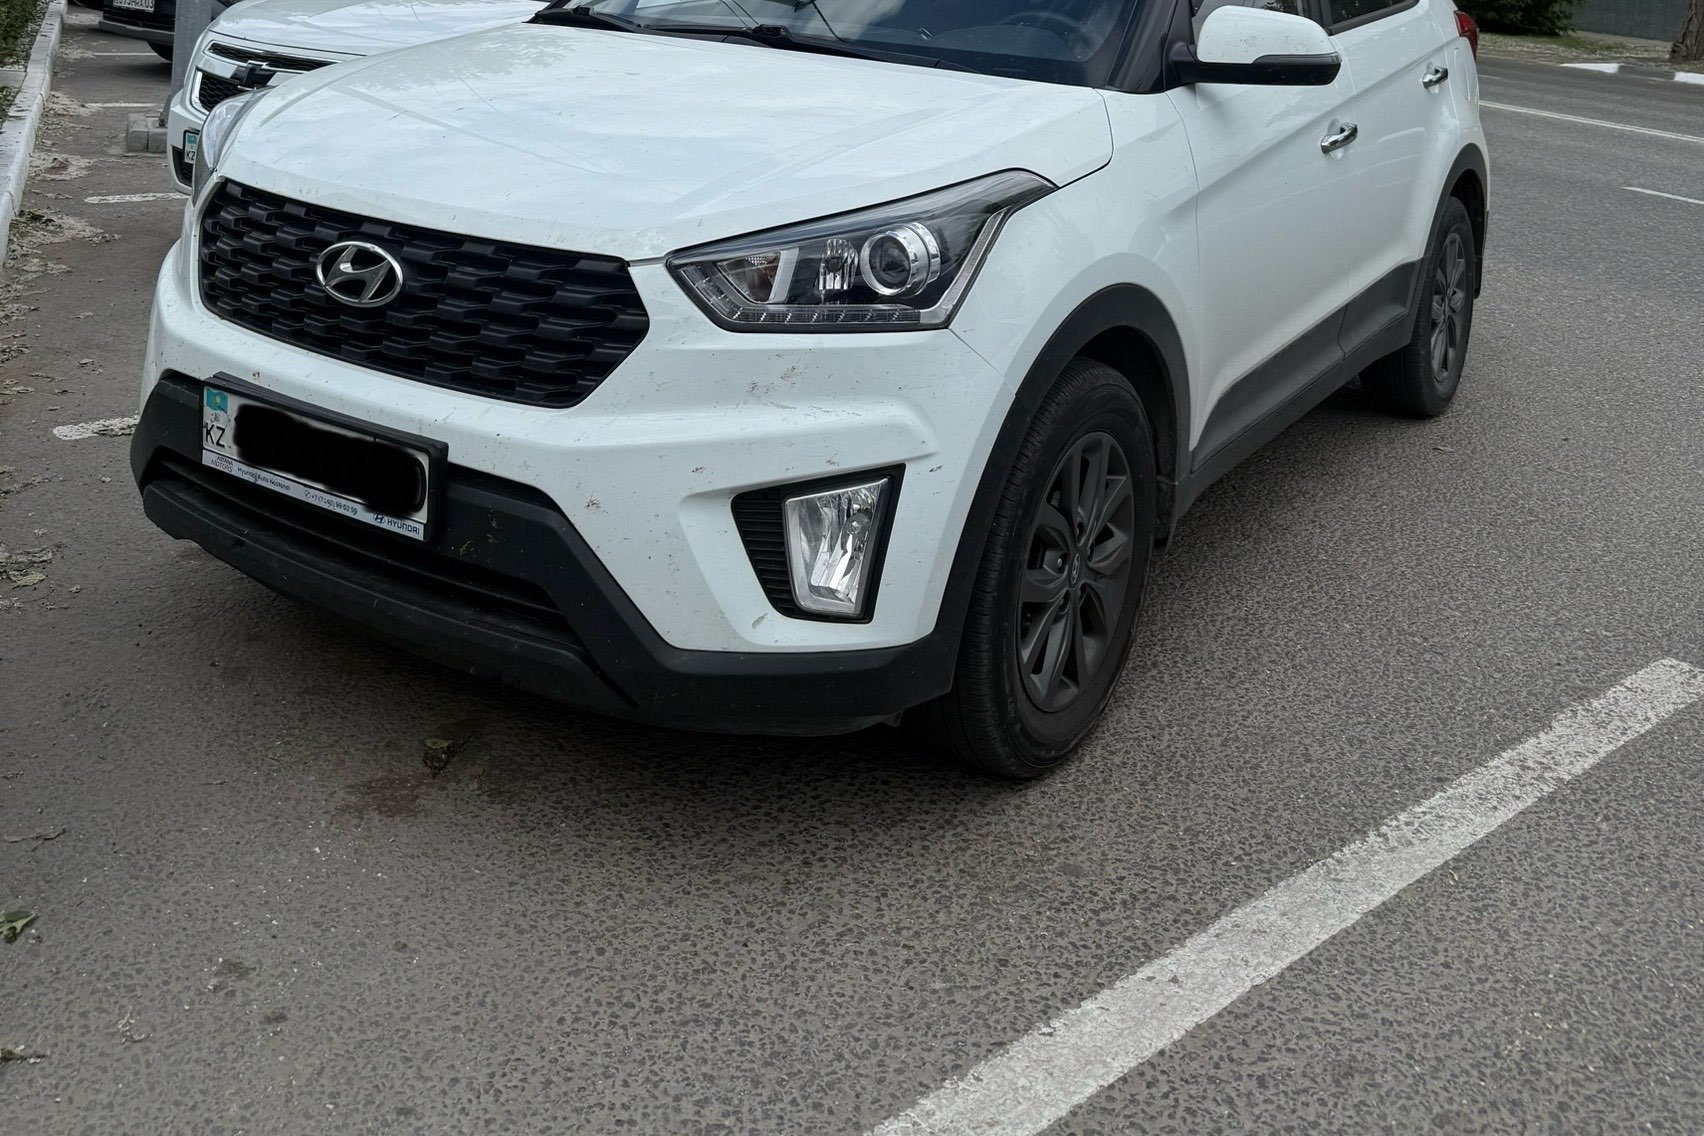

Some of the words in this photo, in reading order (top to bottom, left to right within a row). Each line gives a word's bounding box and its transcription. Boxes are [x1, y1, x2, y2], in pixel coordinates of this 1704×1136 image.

[205, 422, 226, 448] KZ
[211, 459, 234, 473] MOTORS
[387, 518, 420, 534] HYUNDAI
